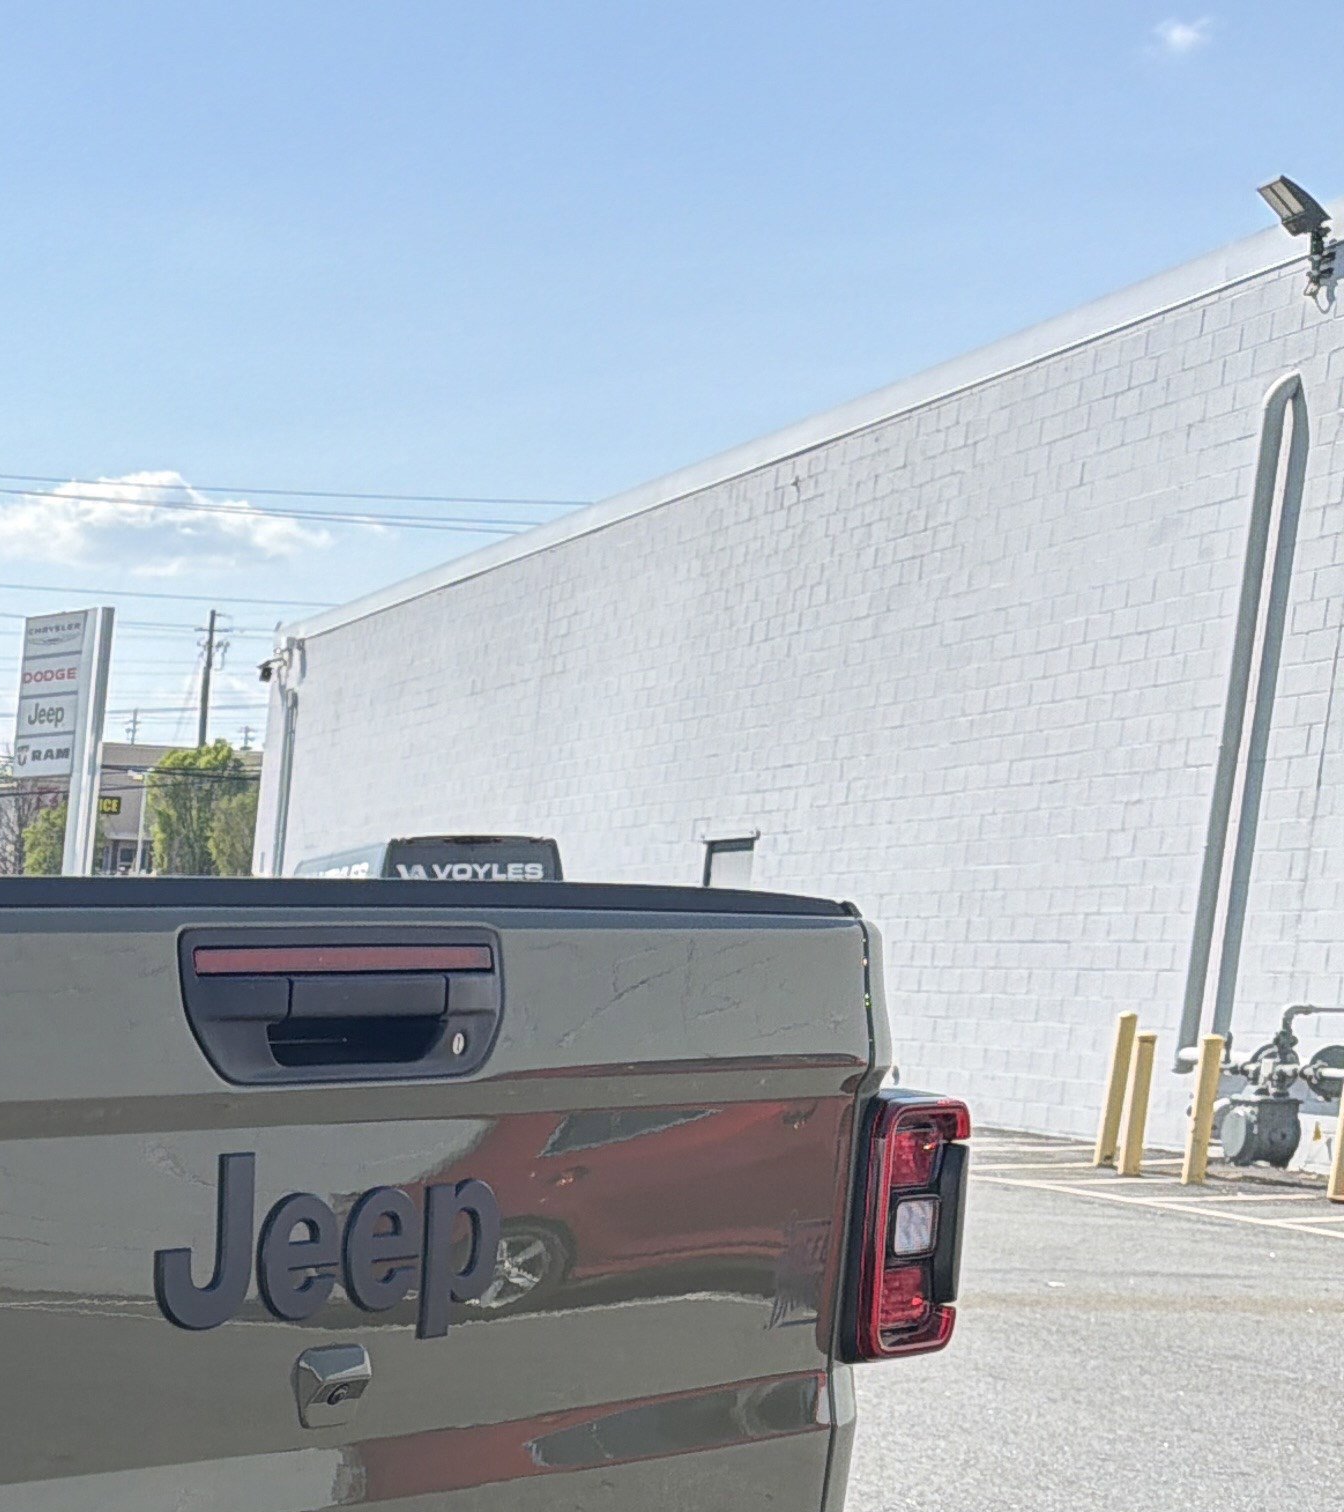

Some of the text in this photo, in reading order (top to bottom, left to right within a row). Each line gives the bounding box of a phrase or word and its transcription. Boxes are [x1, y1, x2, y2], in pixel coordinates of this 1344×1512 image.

[28, 622, 82, 637] CHRYSLER
[23, 667, 77, 685] DODGE
[27, 702, 65, 728] Jeep
[31, 747, 70, 762] RAM
[432, 863, 544, 880] VOYLES
[154, 1152, 502, 1339] Jeep
